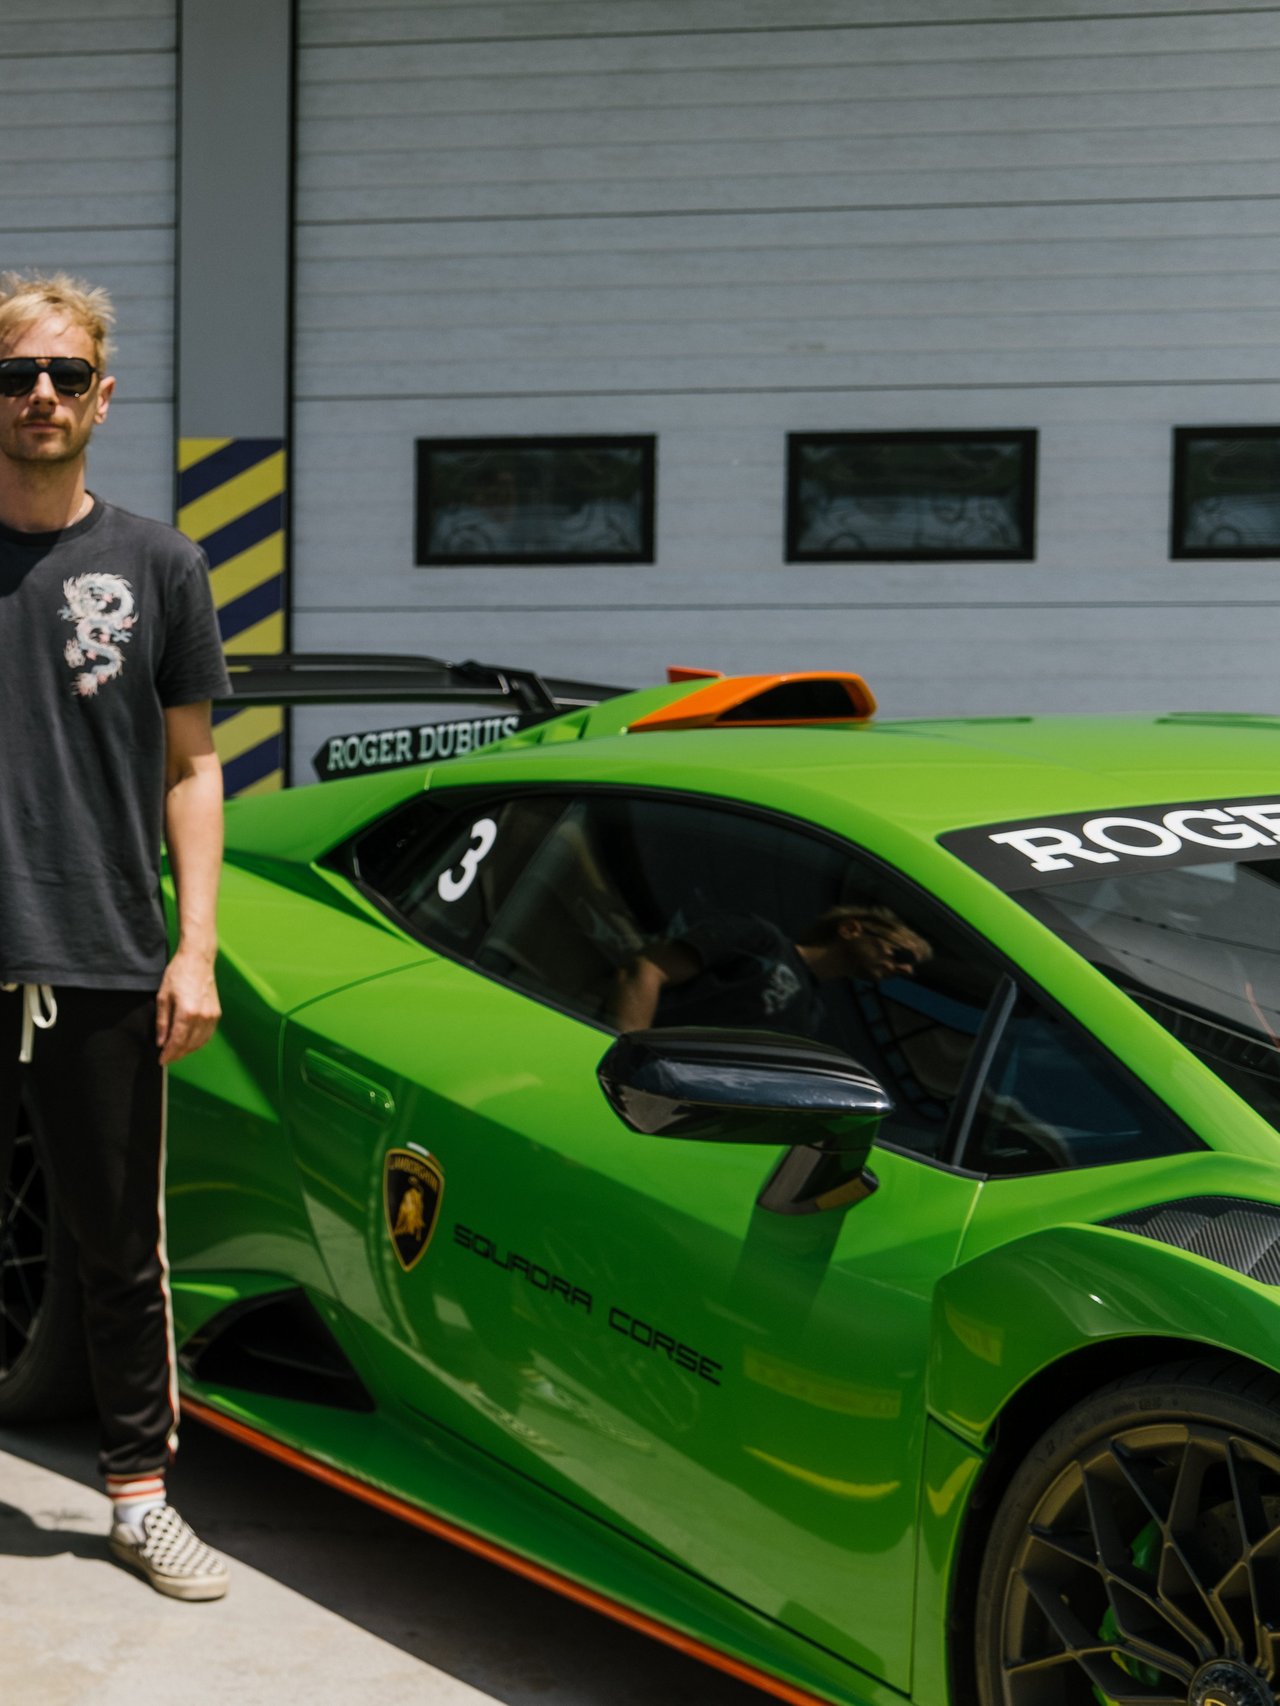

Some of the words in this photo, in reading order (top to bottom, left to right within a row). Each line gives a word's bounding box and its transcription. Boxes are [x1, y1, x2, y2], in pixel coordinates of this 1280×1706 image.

[326, 729, 413, 771] ROGER
[417, 715, 519, 760] DUBUIS
[438, 818, 497, 902] 3
[453, 1223, 593, 1314] SQUADRA
[608, 1306, 723, 1386] CORSE
